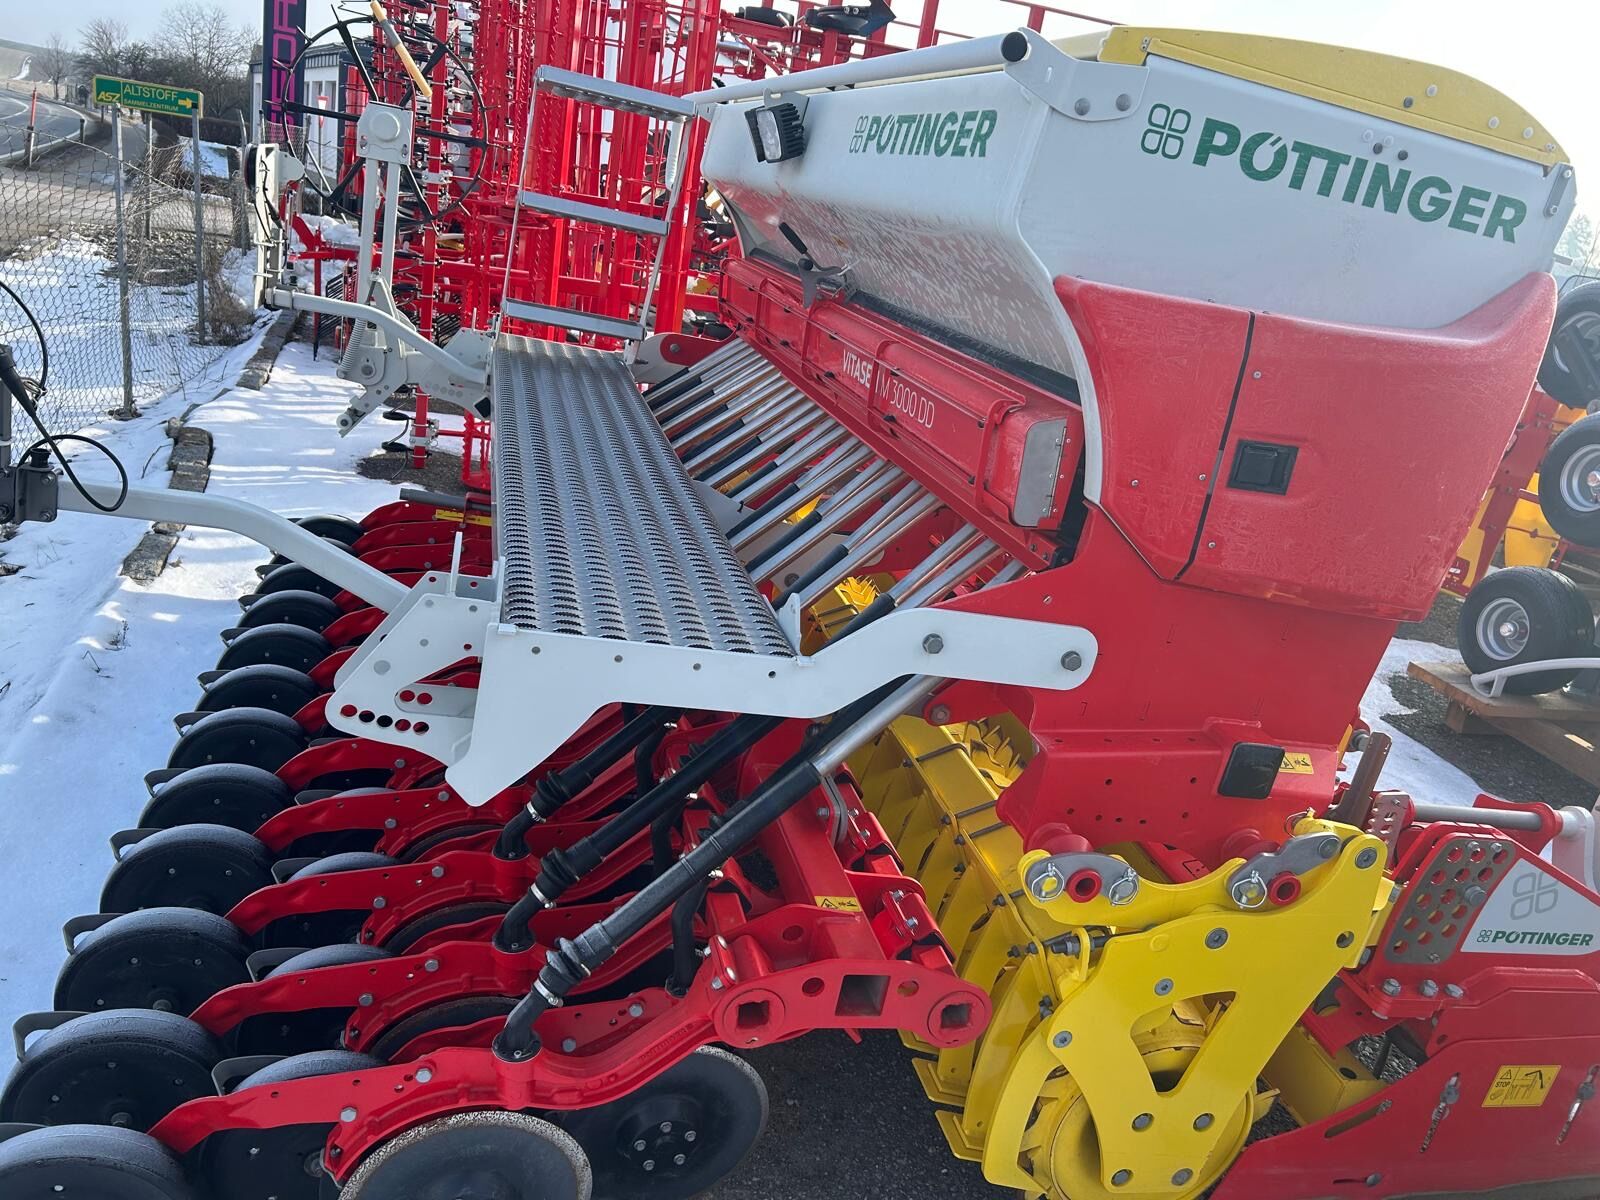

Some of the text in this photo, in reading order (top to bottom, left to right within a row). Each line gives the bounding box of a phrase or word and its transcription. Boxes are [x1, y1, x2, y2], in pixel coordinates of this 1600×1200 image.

[97, 91, 121, 102] ASZ
[123, 84, 179, 101] ALTSTOFF
[123, 99, 179, 111] SAMMELZENTRUM
[861, 109, 998, 158] PÖTTINGER
[1192, 117, 1528, 244] PÖTTINGER
[890, 380, 918, 417] 3000
[918, 397, 935, 428] DD
[1491, 930, 1594, 946] PÖTTINGER
